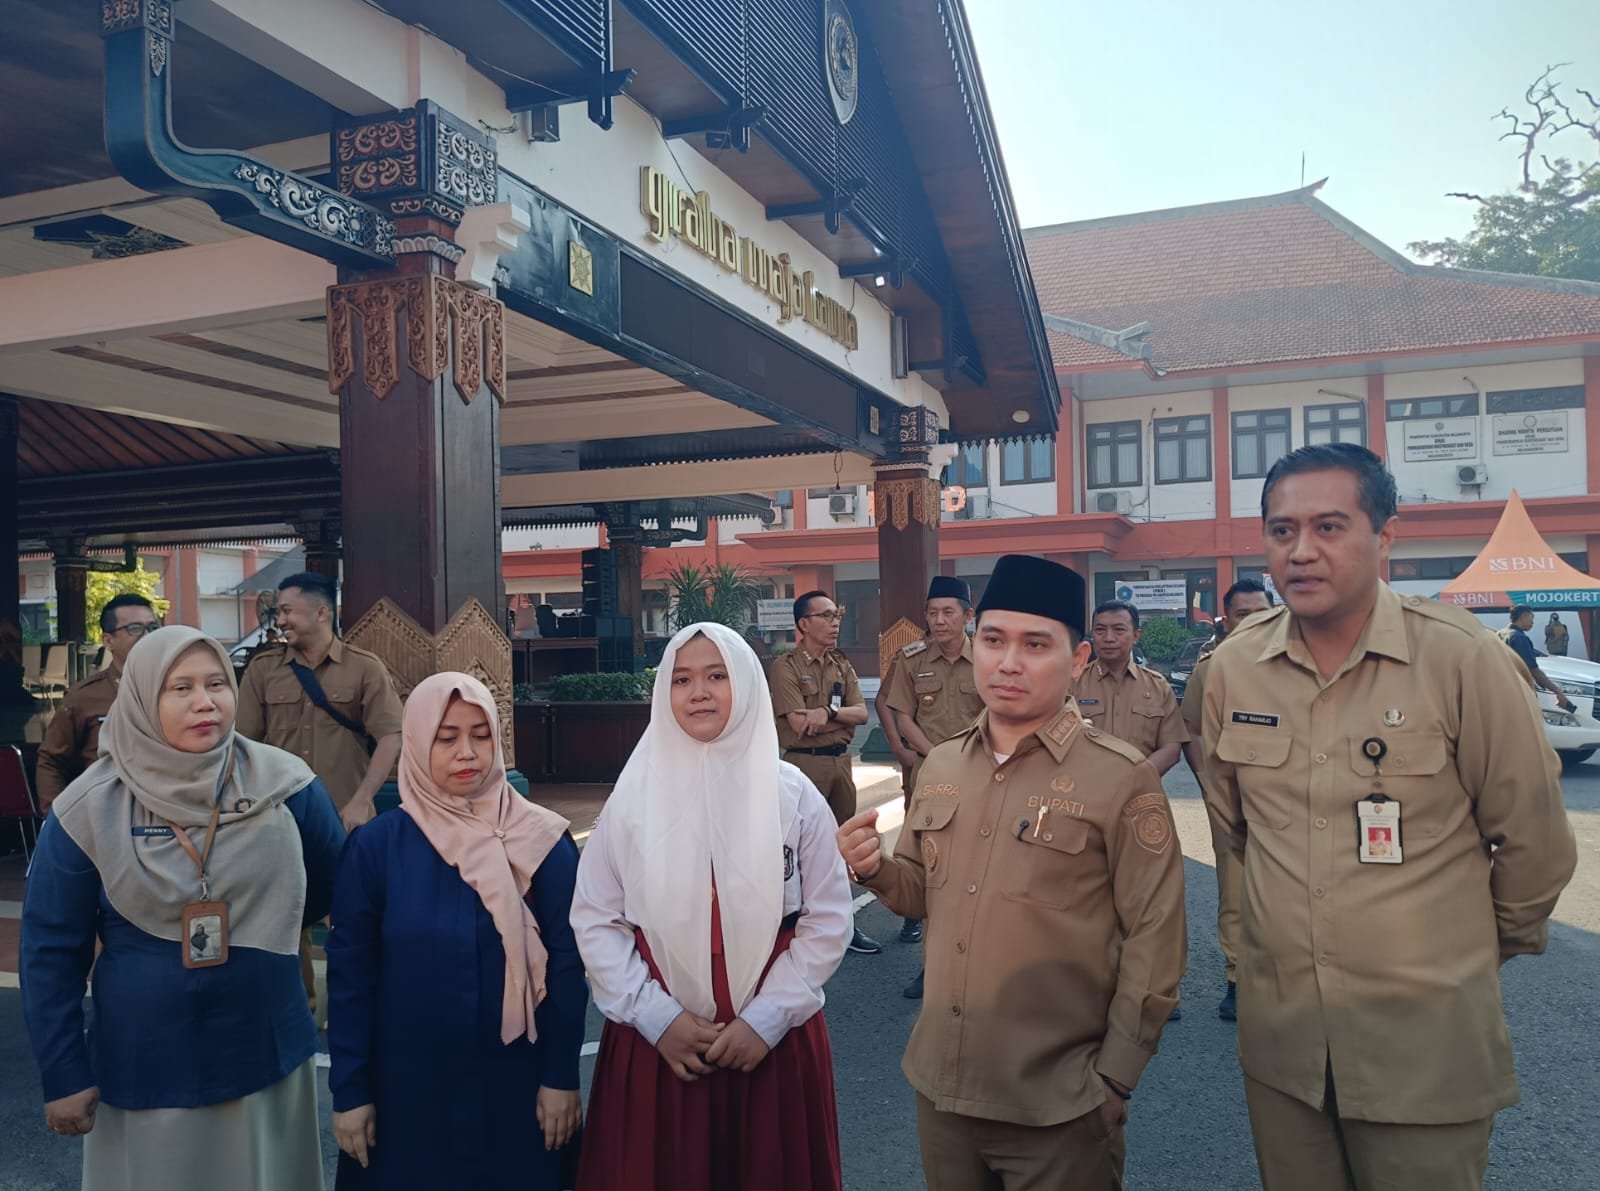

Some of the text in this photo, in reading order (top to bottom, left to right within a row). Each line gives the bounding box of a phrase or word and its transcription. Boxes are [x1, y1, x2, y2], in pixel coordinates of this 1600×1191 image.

[1511, 557, 1555, 570] BNI
[1467, 592, 1494, 604] BNI
[1028, 795, 1085, 816] BUPATI
